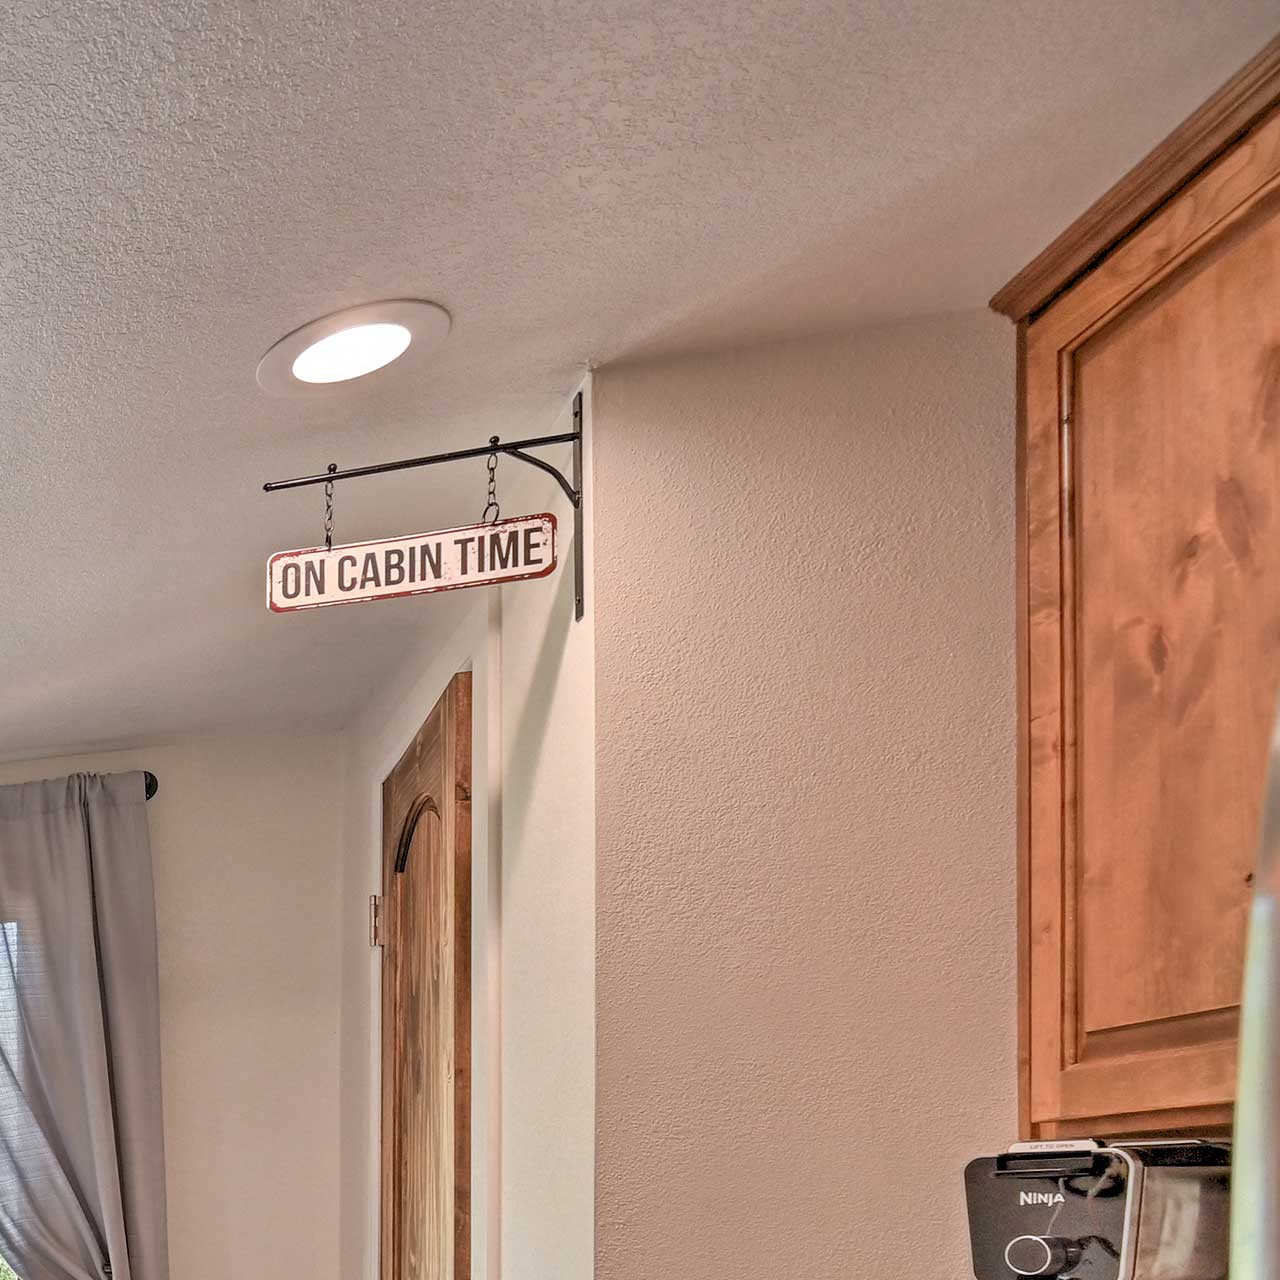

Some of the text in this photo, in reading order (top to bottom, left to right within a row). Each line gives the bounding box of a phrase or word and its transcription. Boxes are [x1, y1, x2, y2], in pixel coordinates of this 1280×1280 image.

[282, 526, 543, 599] ON CABIN TIME
[1020, 1191, 1065, 1207] NINJA
